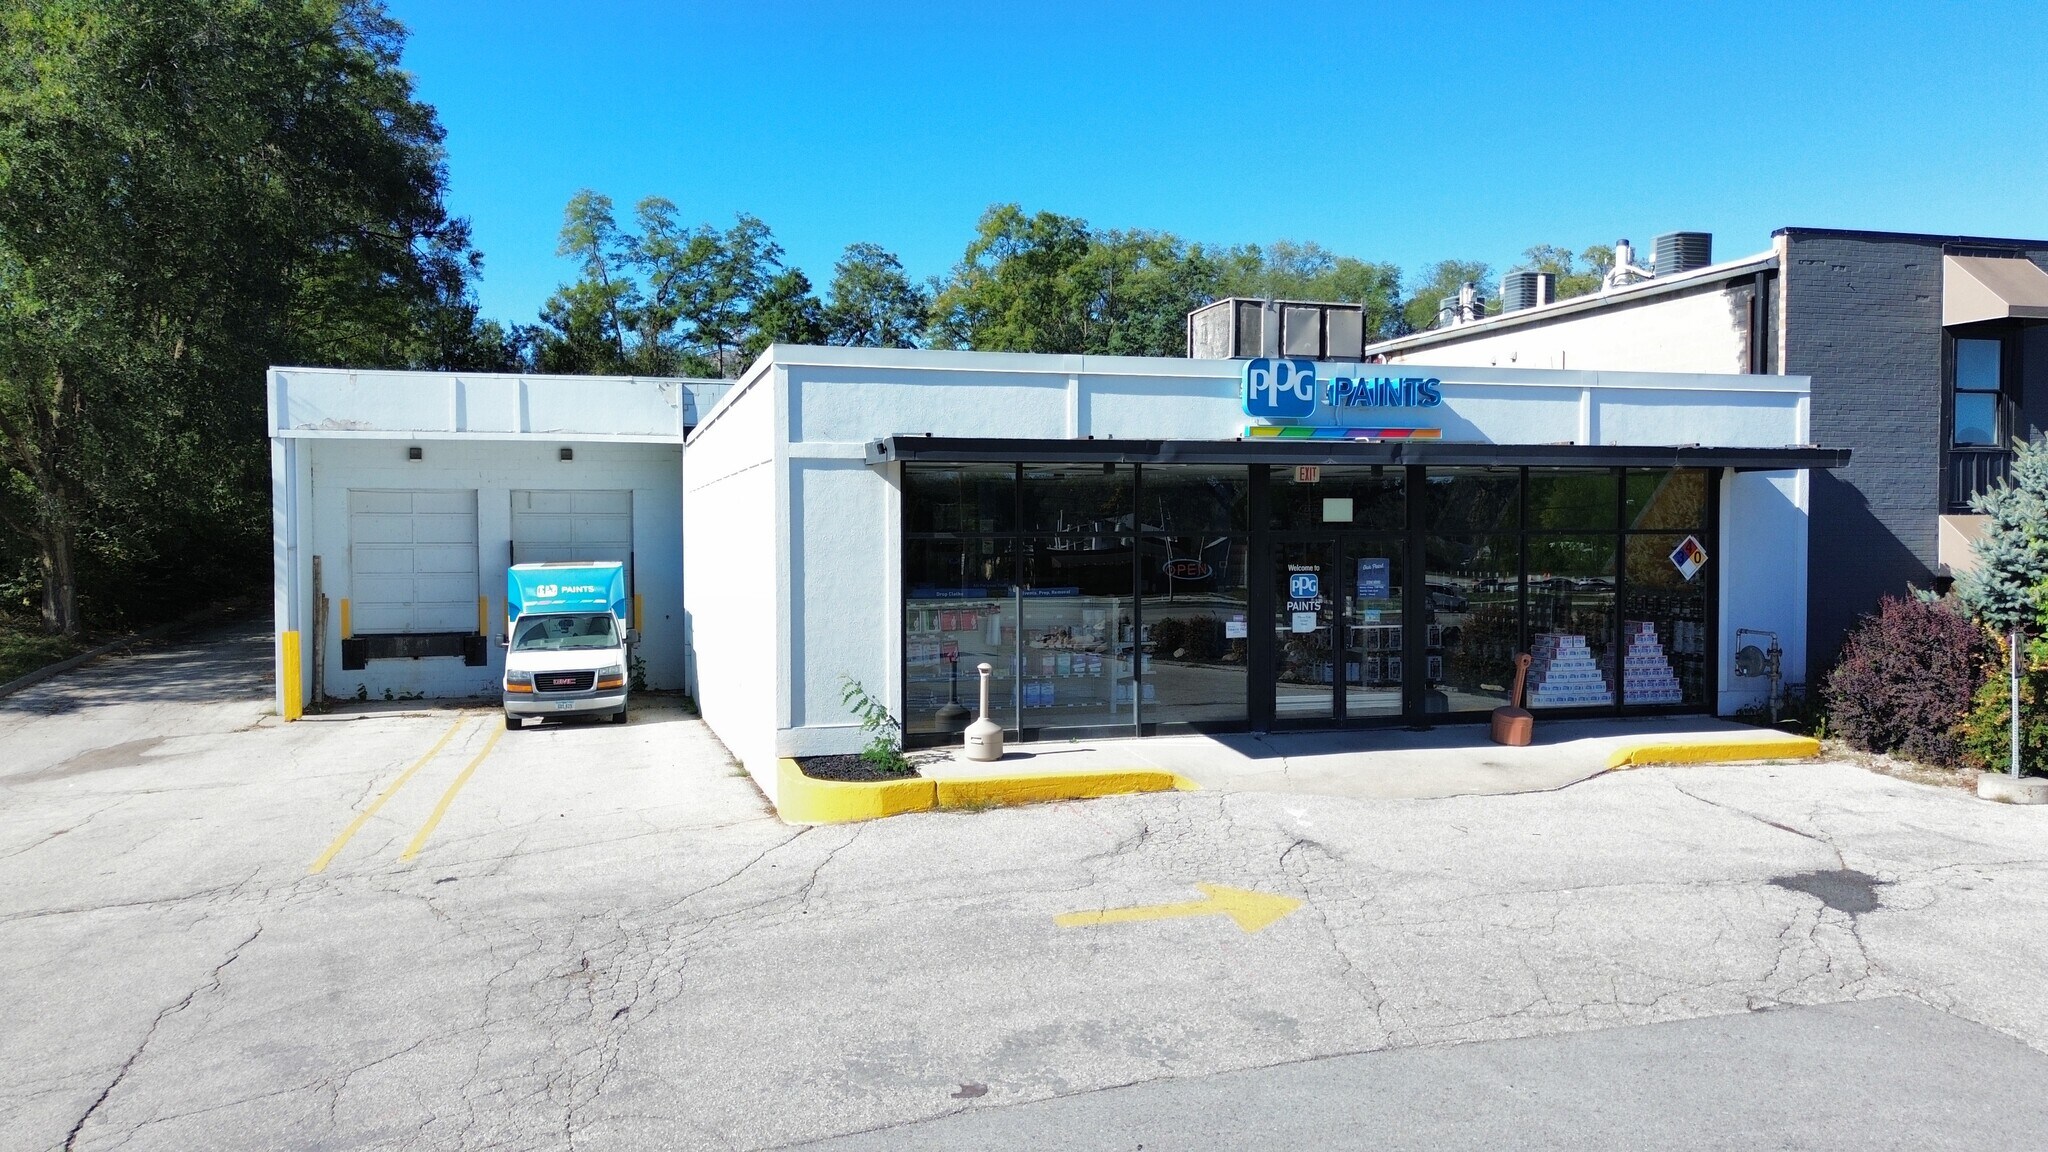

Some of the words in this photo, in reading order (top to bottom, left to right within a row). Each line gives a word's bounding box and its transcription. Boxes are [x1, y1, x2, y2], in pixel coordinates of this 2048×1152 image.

[1249, 359, 1314, 407] PPG
[1332, 377, 1443, 407] PAINTS
[1299, 466, 1317, 481] EXIT
[1685, 542, 1692, 554] 4
[1677, 551, 1685, 564] 3
[1693, 551, 1702, 564] 0
[1165, 563, 1207, 576] OPEN
[1287, 564, 1313, 572] Welcome
[1313, 564, 1320, 572] to
[561, 585, 595, 593] PAINTS
[1292, 576, 1316, 596] PPG
[1286, 601, 1321, 611] PAINTS
